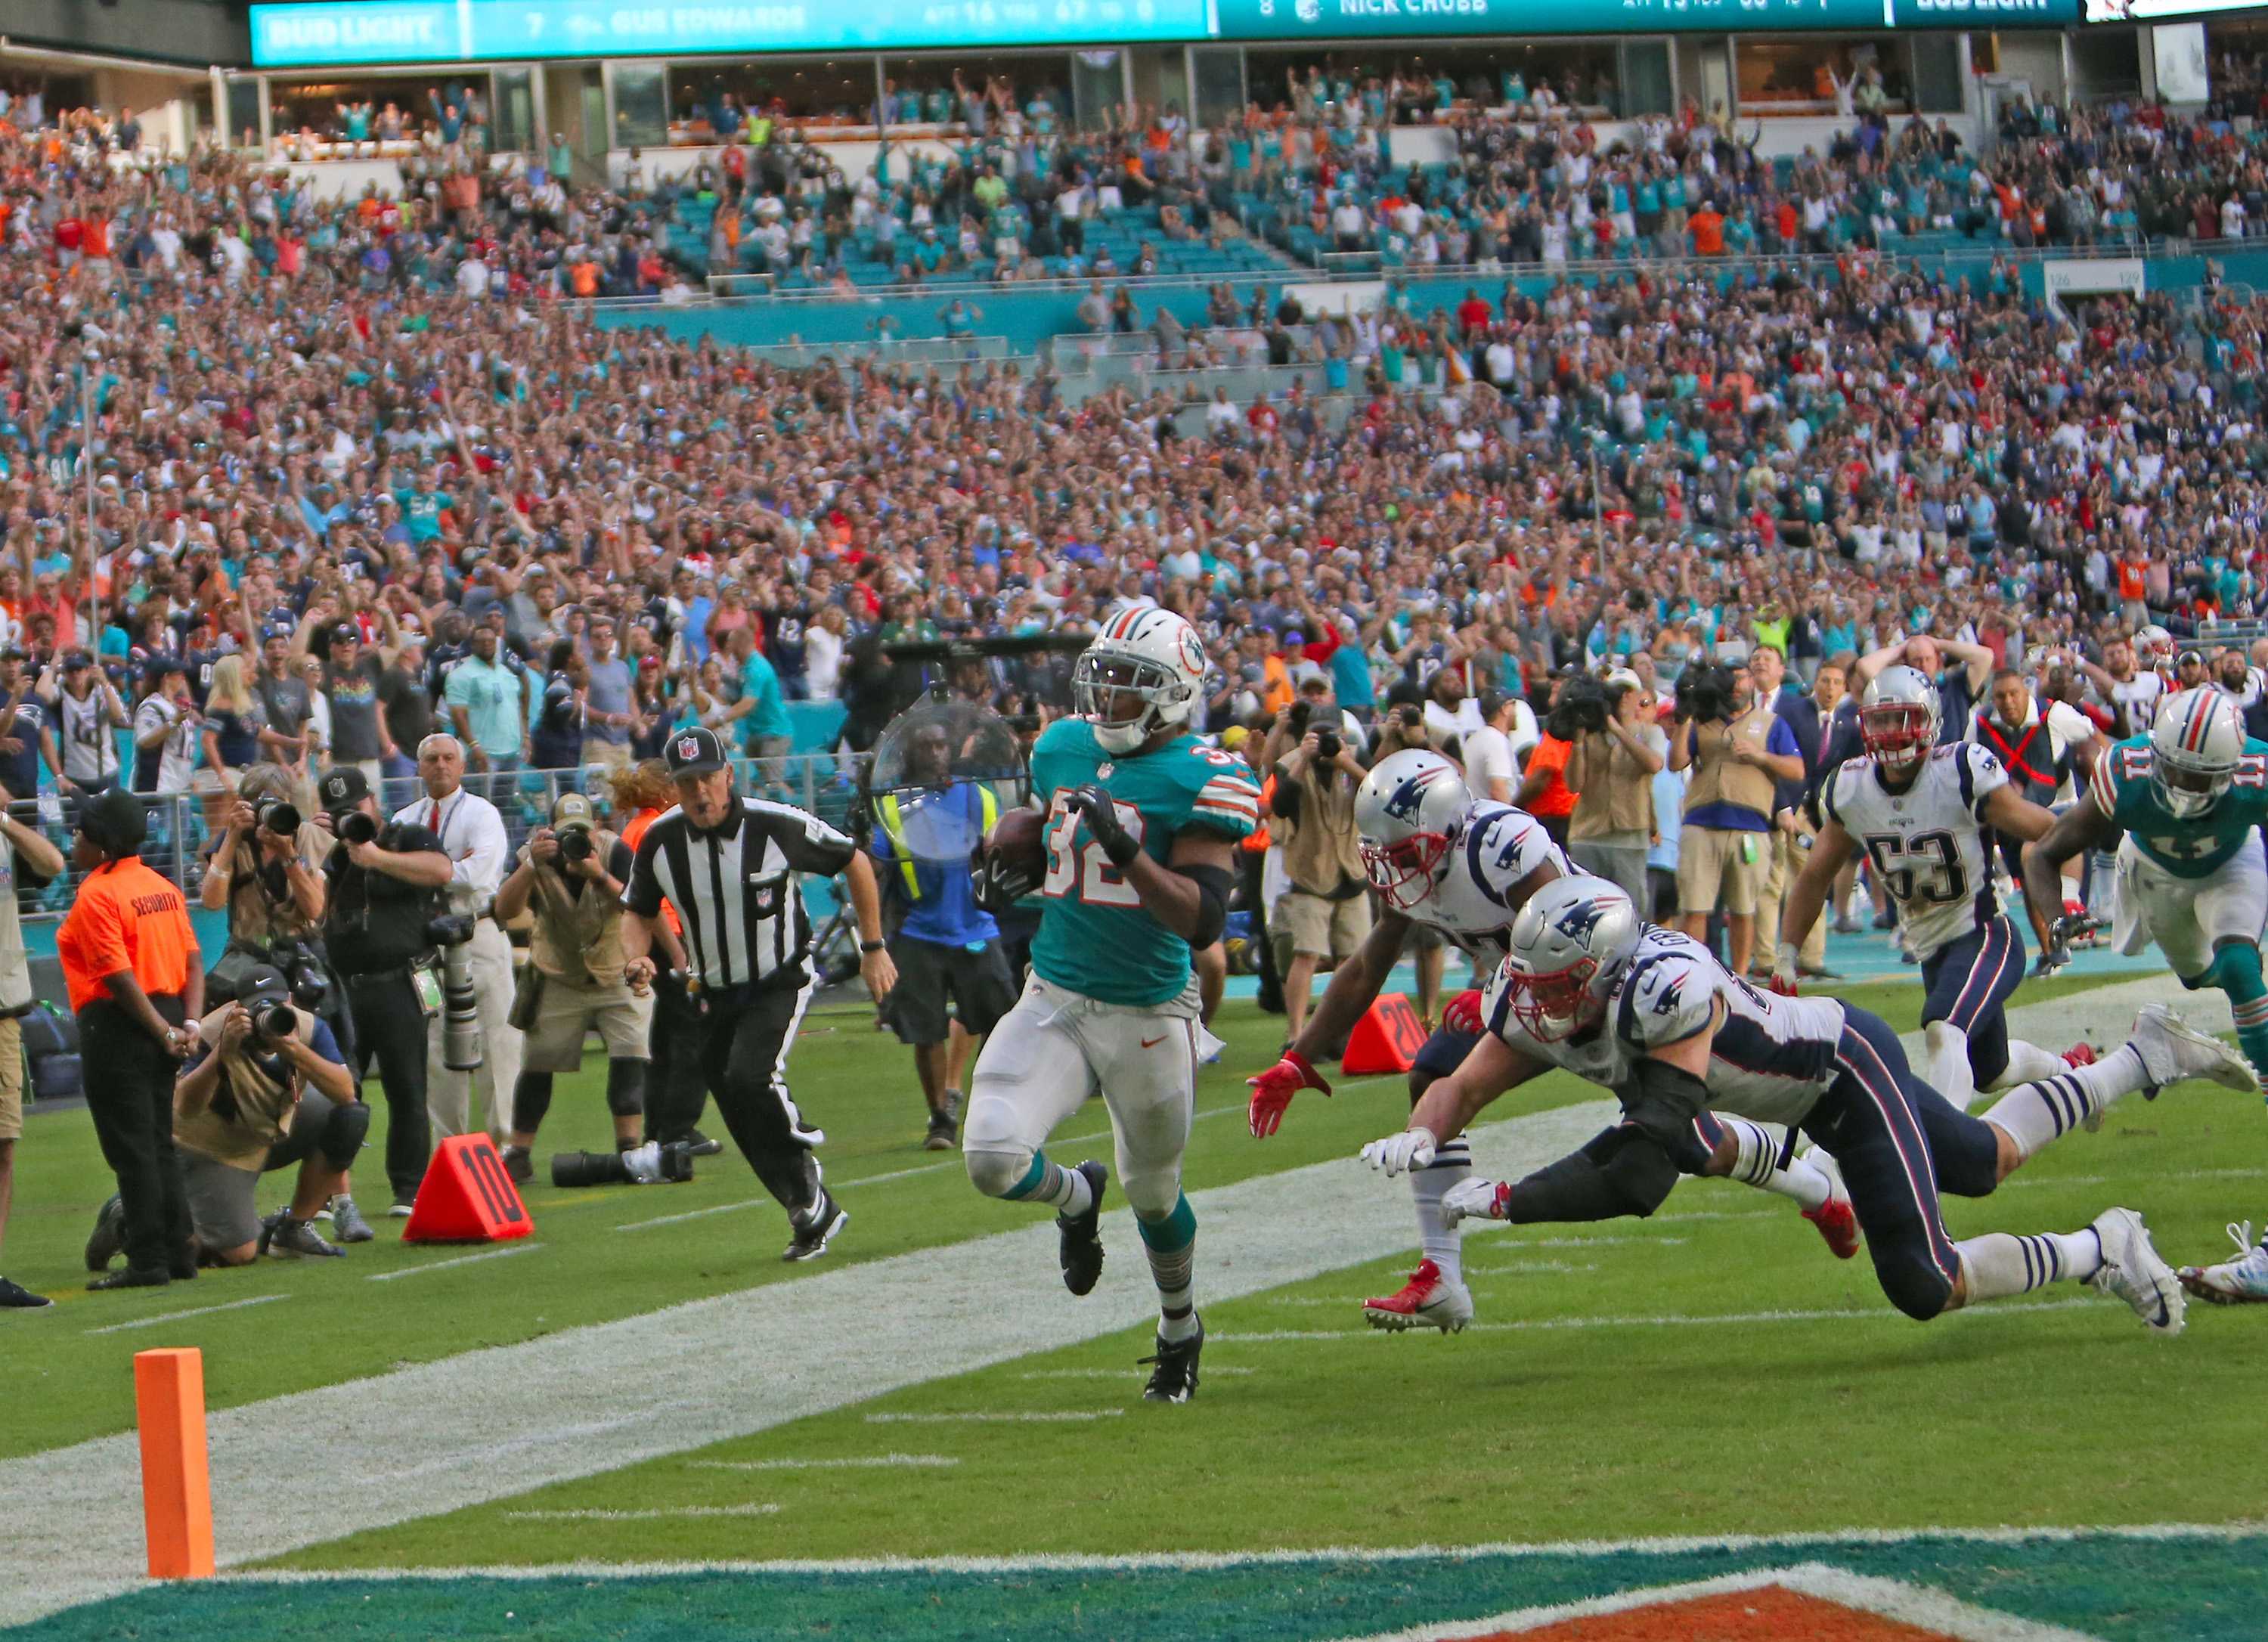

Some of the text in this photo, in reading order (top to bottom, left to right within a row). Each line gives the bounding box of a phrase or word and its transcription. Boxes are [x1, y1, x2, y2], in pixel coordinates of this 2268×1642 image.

[267, 14, 433, 48] BUD LIGHT
[528, 5, 804, 39] 7 GUS EDWARDS
[2050, 271, 2070, 286] 126
[2119, 271, 2140, 285] 129
[1042, 785, 1147, 908] 32
[1862, 828, 1969, 903] 53
[1378, 1000, 1428, 1061] 20
[459, 1144, 523, 1225] 10
